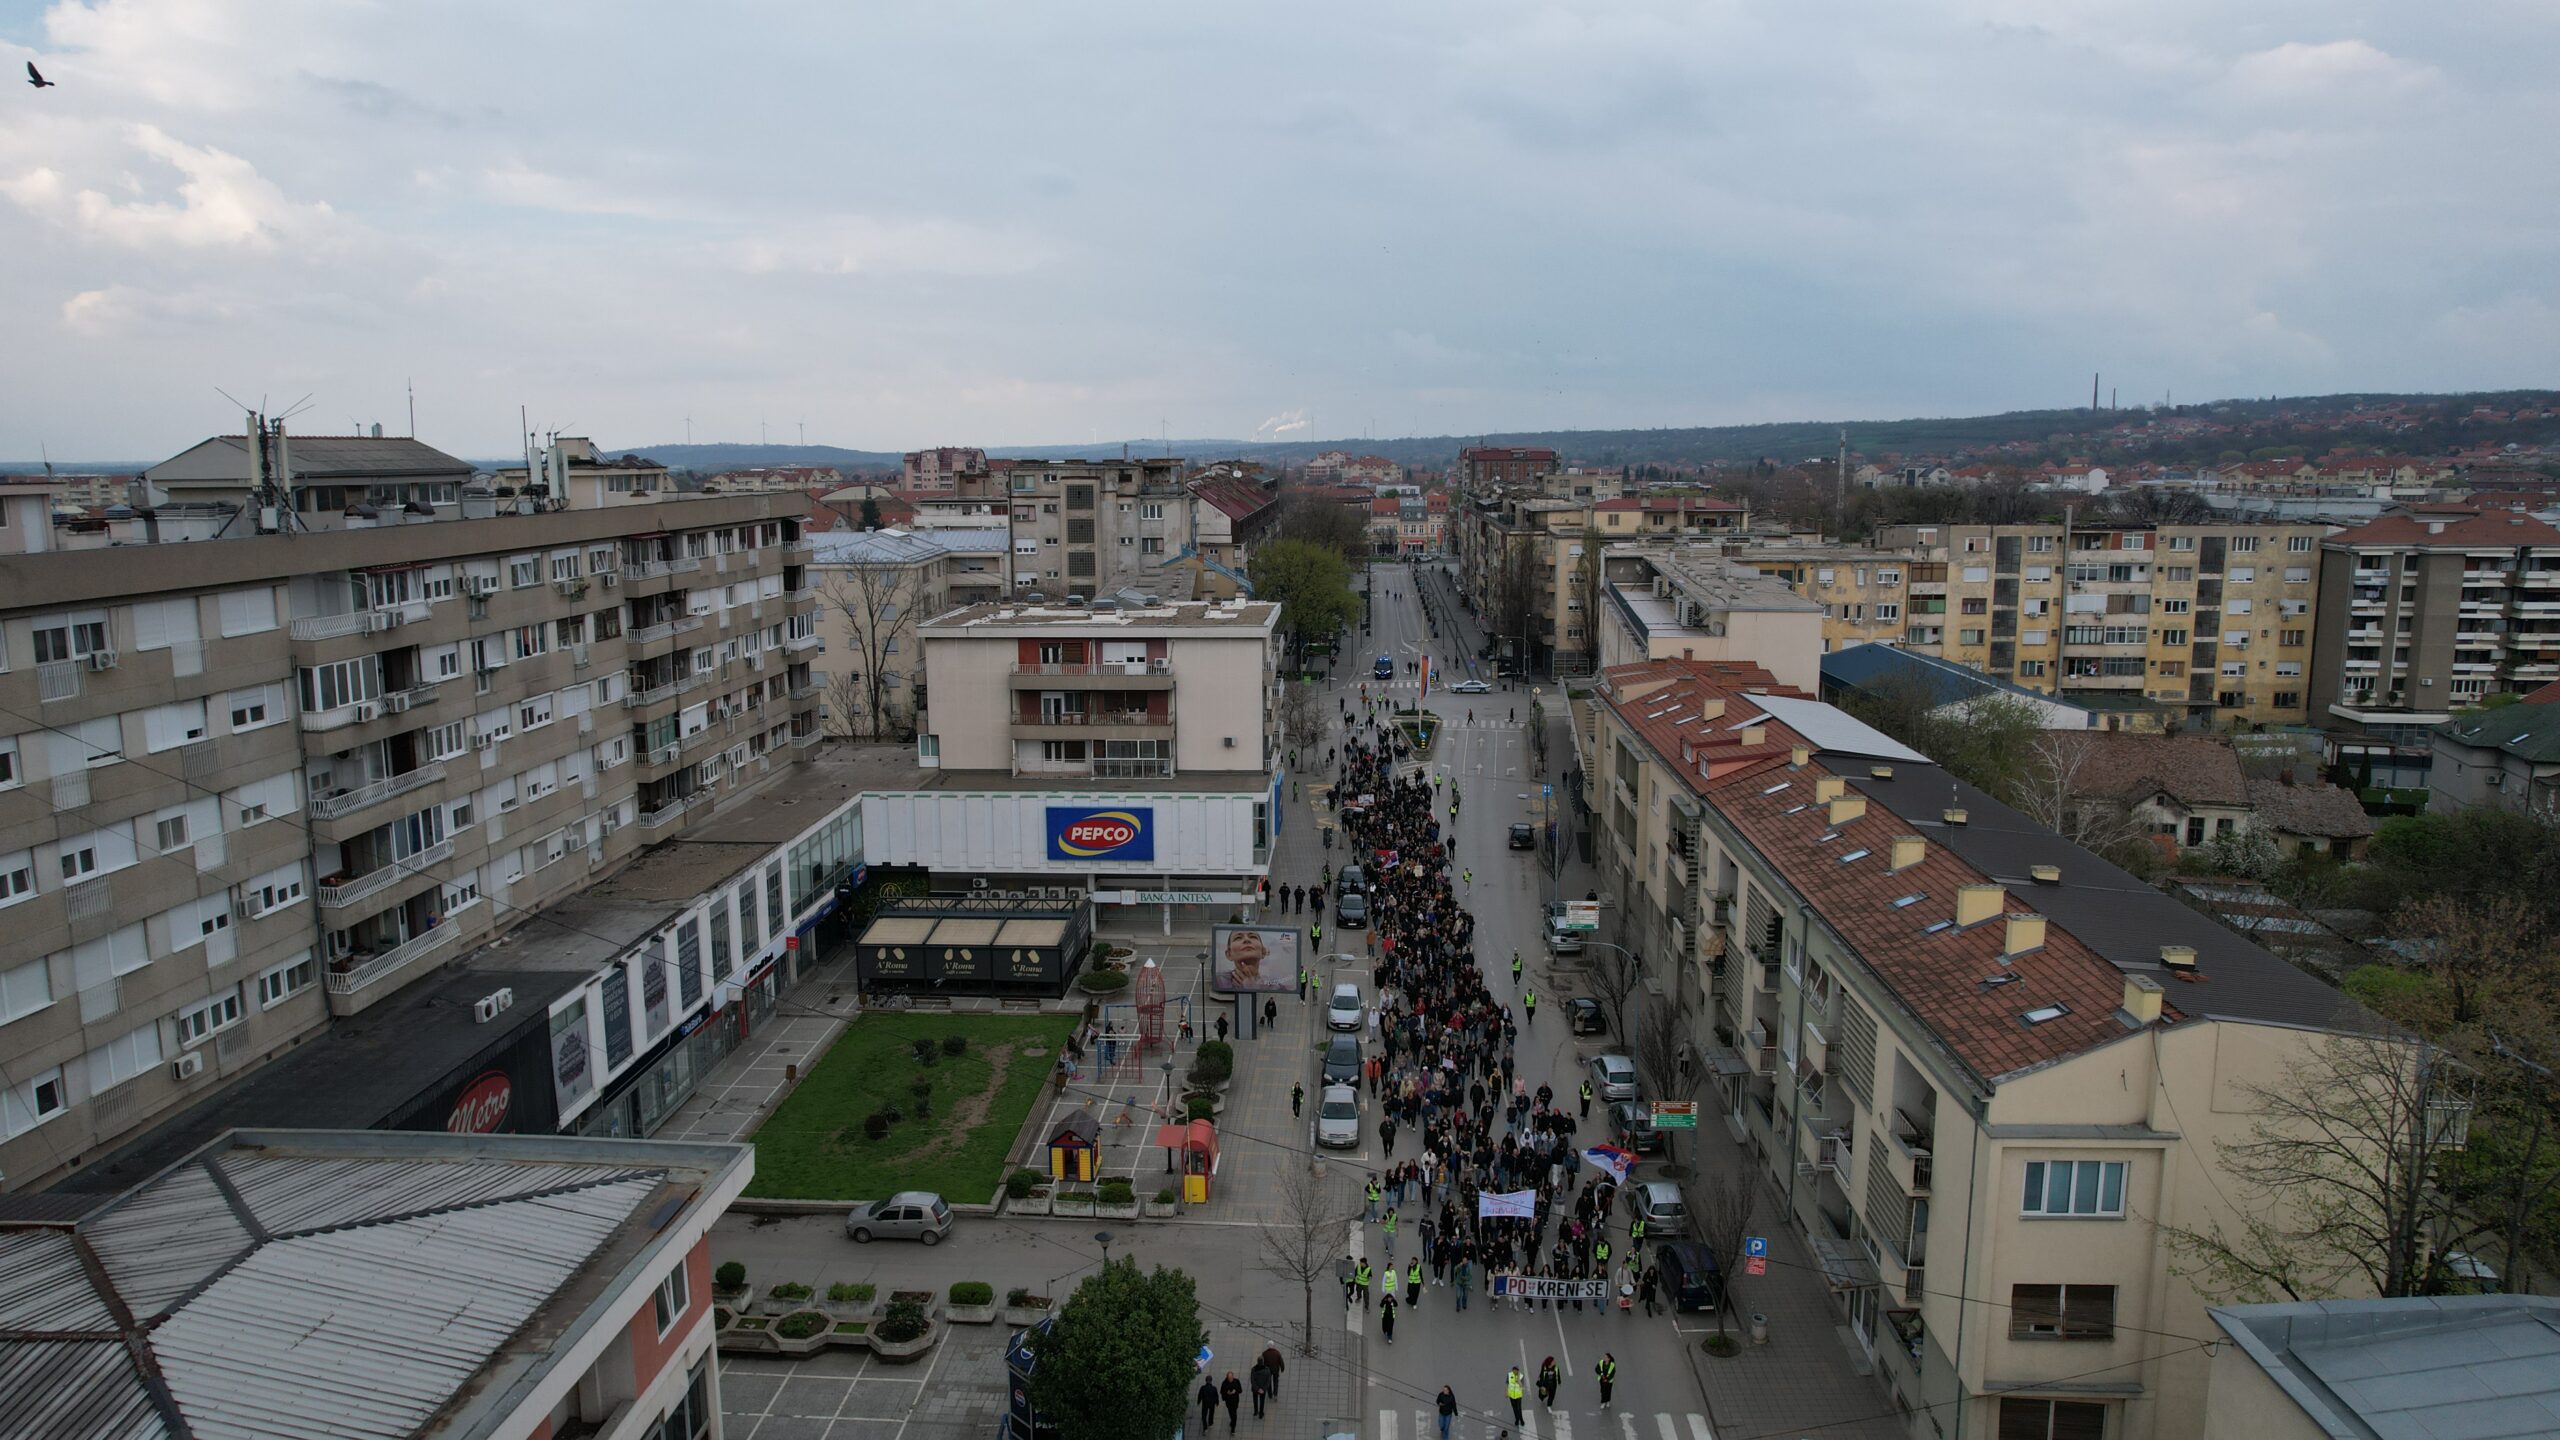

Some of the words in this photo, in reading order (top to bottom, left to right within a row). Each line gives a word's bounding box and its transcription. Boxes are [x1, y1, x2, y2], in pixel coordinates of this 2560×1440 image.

[1071, 827, 1129, 841] PEPCO
[1140, 893, 1174, 902] BANCA
[1178, 893, 1213, 903] INTESA
[876, 961, 908, 969] A'Roma
[942, 962, 976, 970] A'Roma
[1010, 964, 1043, 973] A'Roma
[447, 1087, 510, 1134] Metro
[1751, 1240, 1763, 1255] P
[1508, 1279, 1527, 1295] PO
[1537, 1281, 1604, 1297] KRENI-SE
